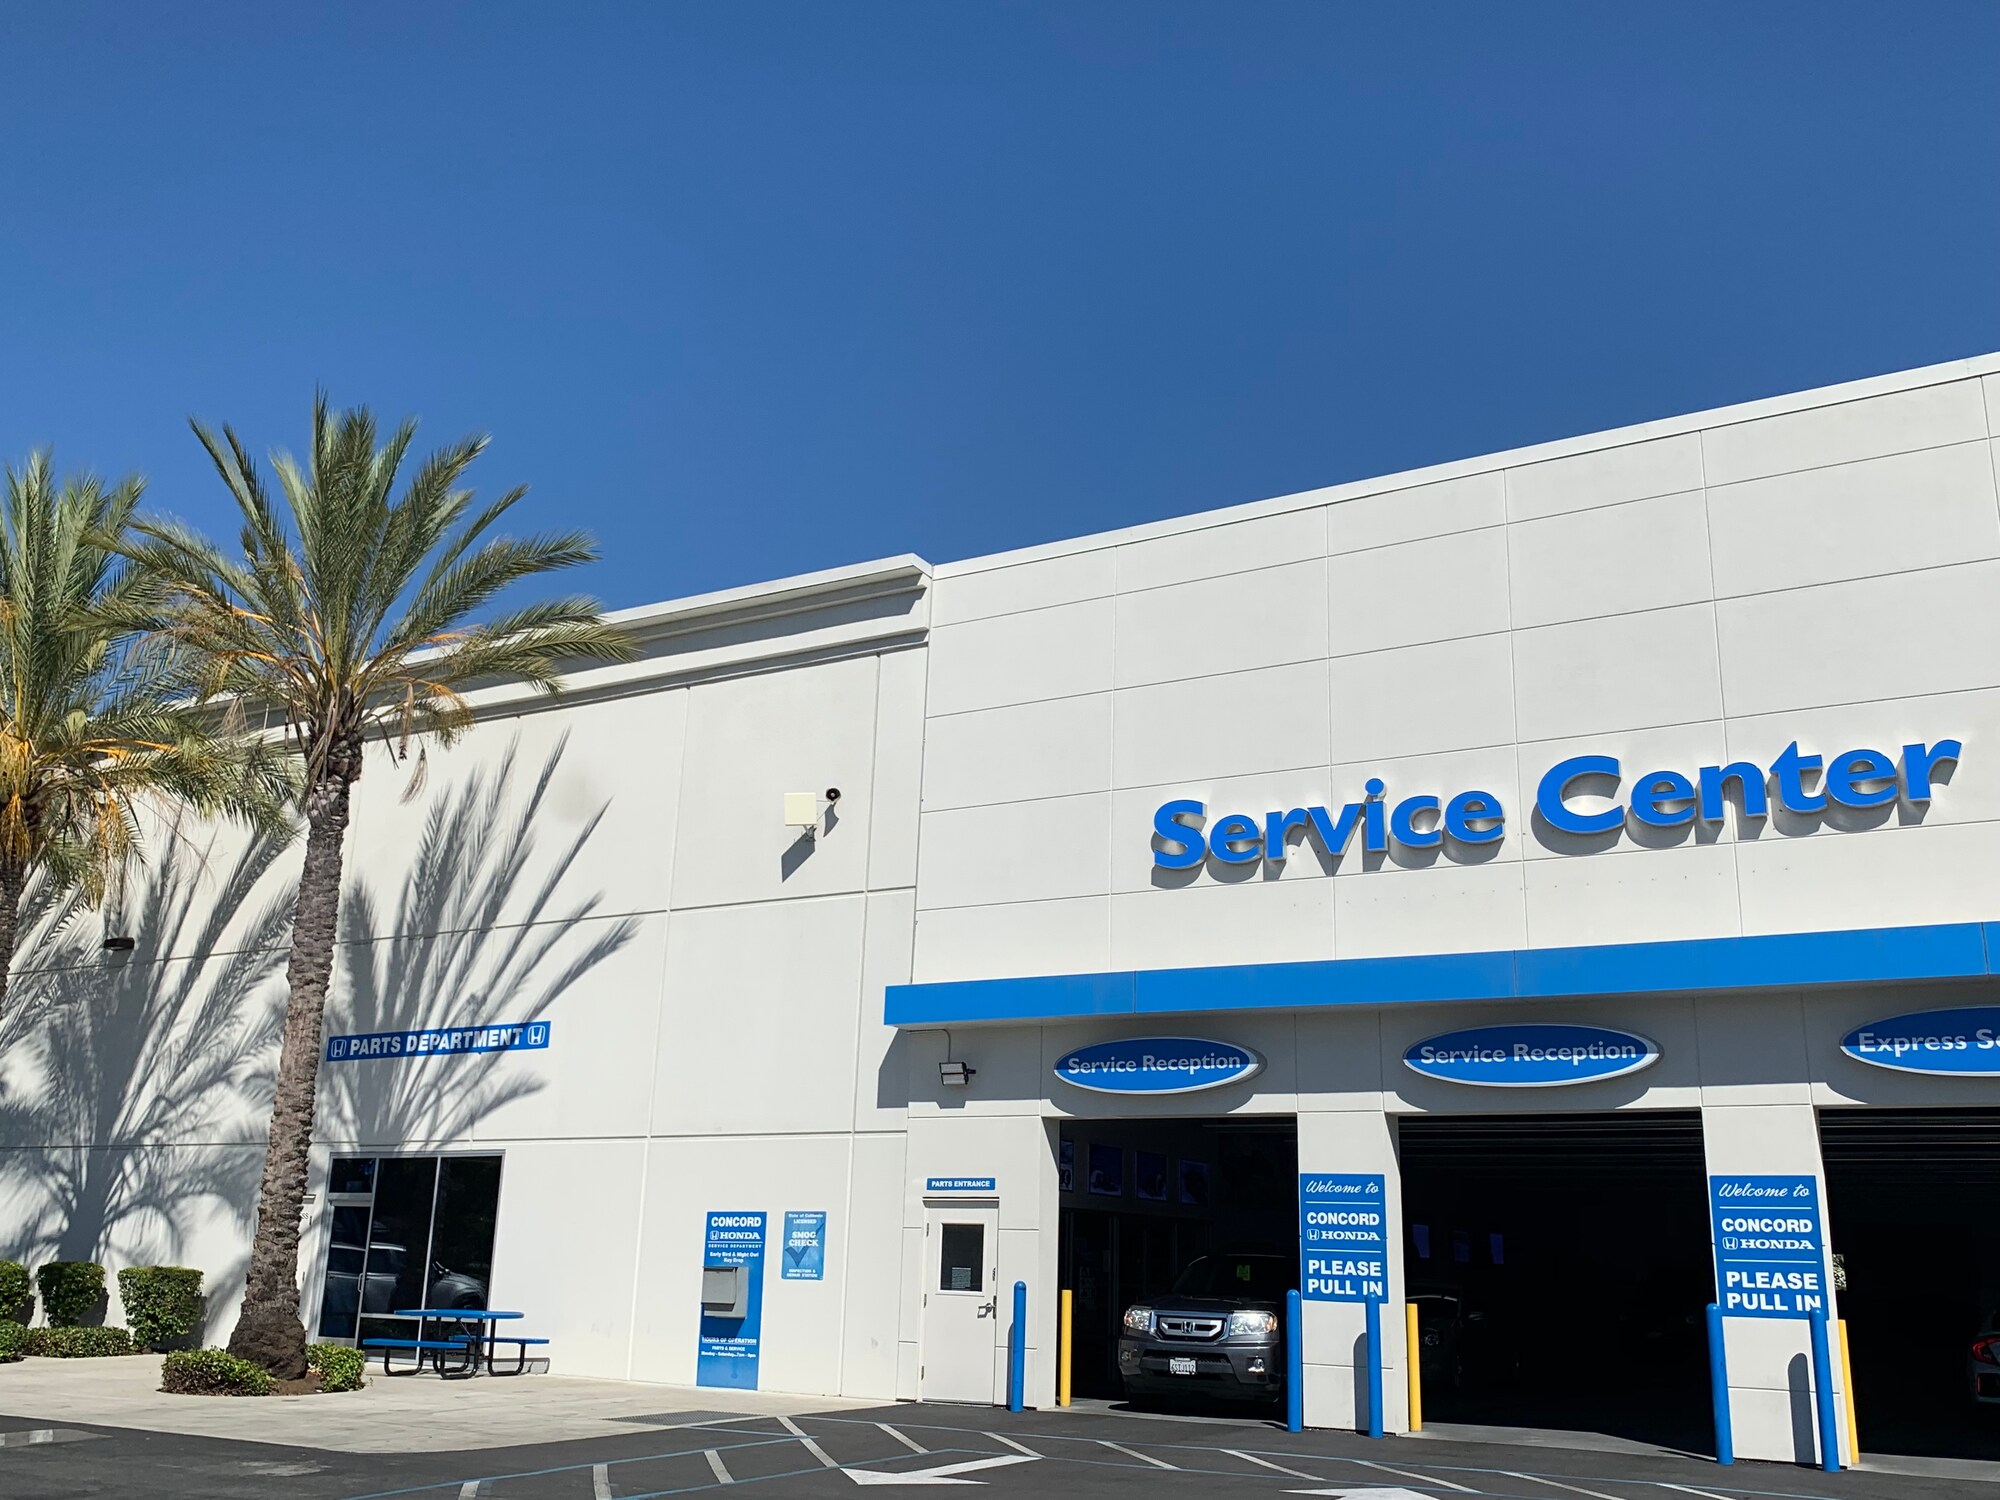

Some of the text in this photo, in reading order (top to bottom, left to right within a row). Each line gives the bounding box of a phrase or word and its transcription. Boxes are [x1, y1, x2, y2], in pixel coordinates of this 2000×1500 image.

[1152, 738, 1962, 871] Service Center
[350, 1027, 524, 1056] PARTS DEPARTMENT
[1858, 1028, 2000, 1058] Express S
[1420, 1041, 1637, 1066] Service Reception
[1068, 1052, 1241, 1075] Service Reception
[931, 1180, 991, 1188] PARTS ENTRANCE
[1305, 1180, 1379, 1194] Welcome to
[1718, 1182, 1810, 1197] Welcome to
[711, 1216, 762, 1227] CONCORD
[1306, 1211, 1380, 1226] CONCORD
[1721, 1218, 1813, 1233] CONCORD
[719, 1231, 761, 1240] HONDA
[791, 1231, 817, 1239] SMOG
[1320, 1230, 1381, 1241] HONDA
[788, 1239, 819, 1247] CHECK
[1740, 1238, 1815, 1250] HONDA
[1308, 1259, 1382, 1277] PLEASE
[1307, 1279, 1383, 1296] PULL IN
[1726, 1271, 1819, 1290] PLEASE
[1726, 1292, 1822, 1312] PULL IN
